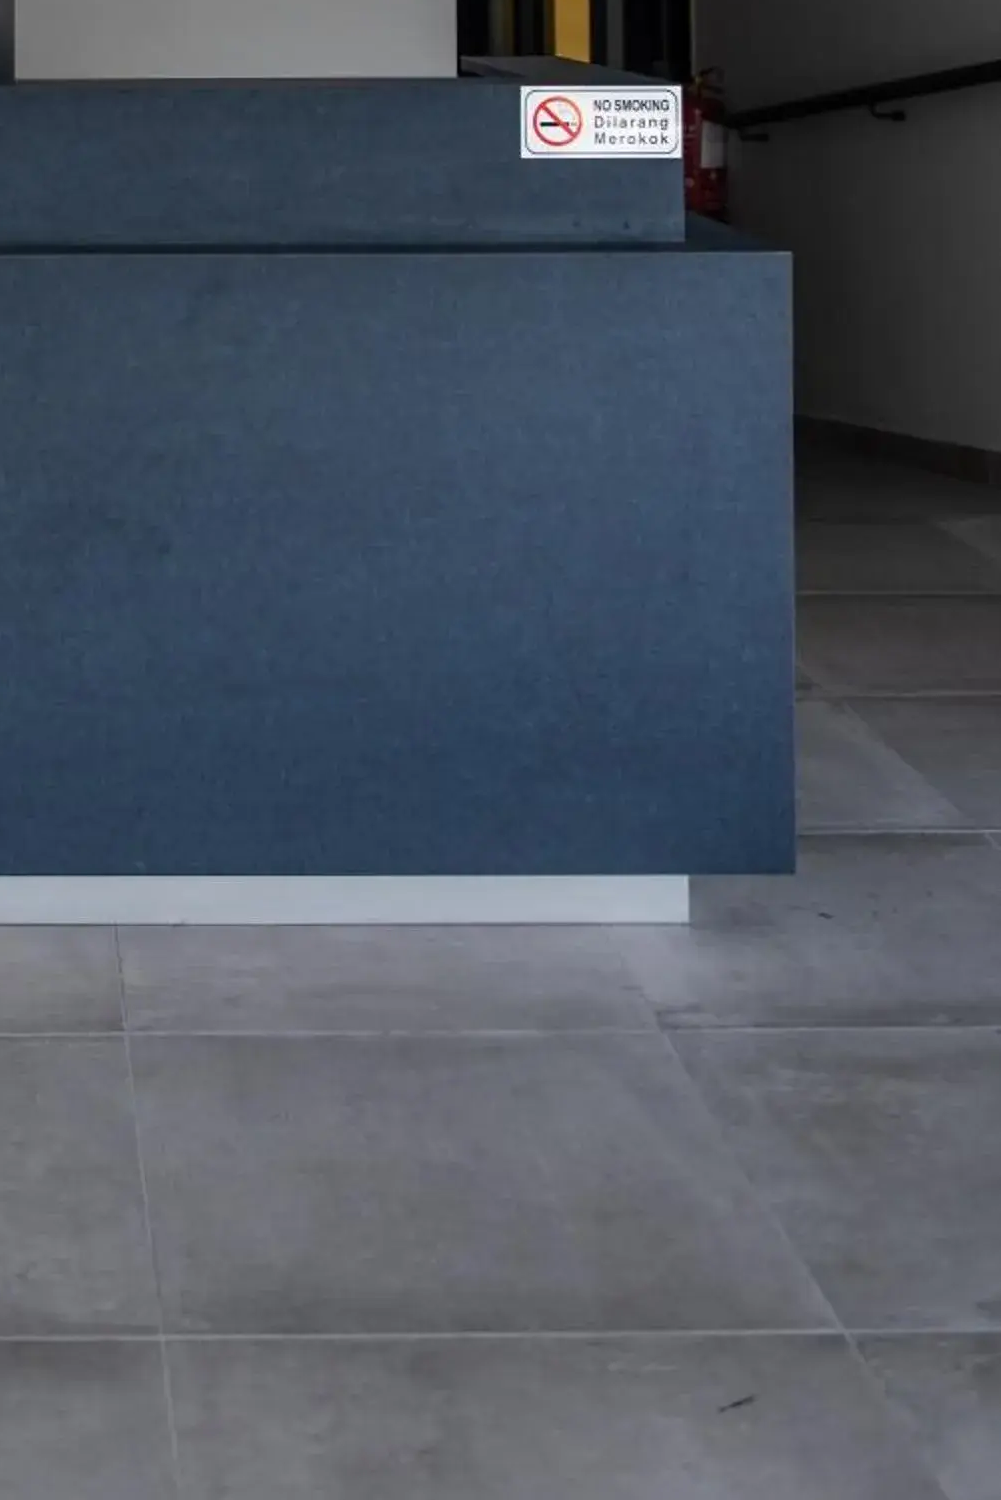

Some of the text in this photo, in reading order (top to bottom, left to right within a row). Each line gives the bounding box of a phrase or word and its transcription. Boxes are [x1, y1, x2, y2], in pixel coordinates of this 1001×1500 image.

[593, 99, 670, 112] NO SMOKING
[594, 115, 669, 130] Dilarang
[594, 132, 669, 145] Merokok
